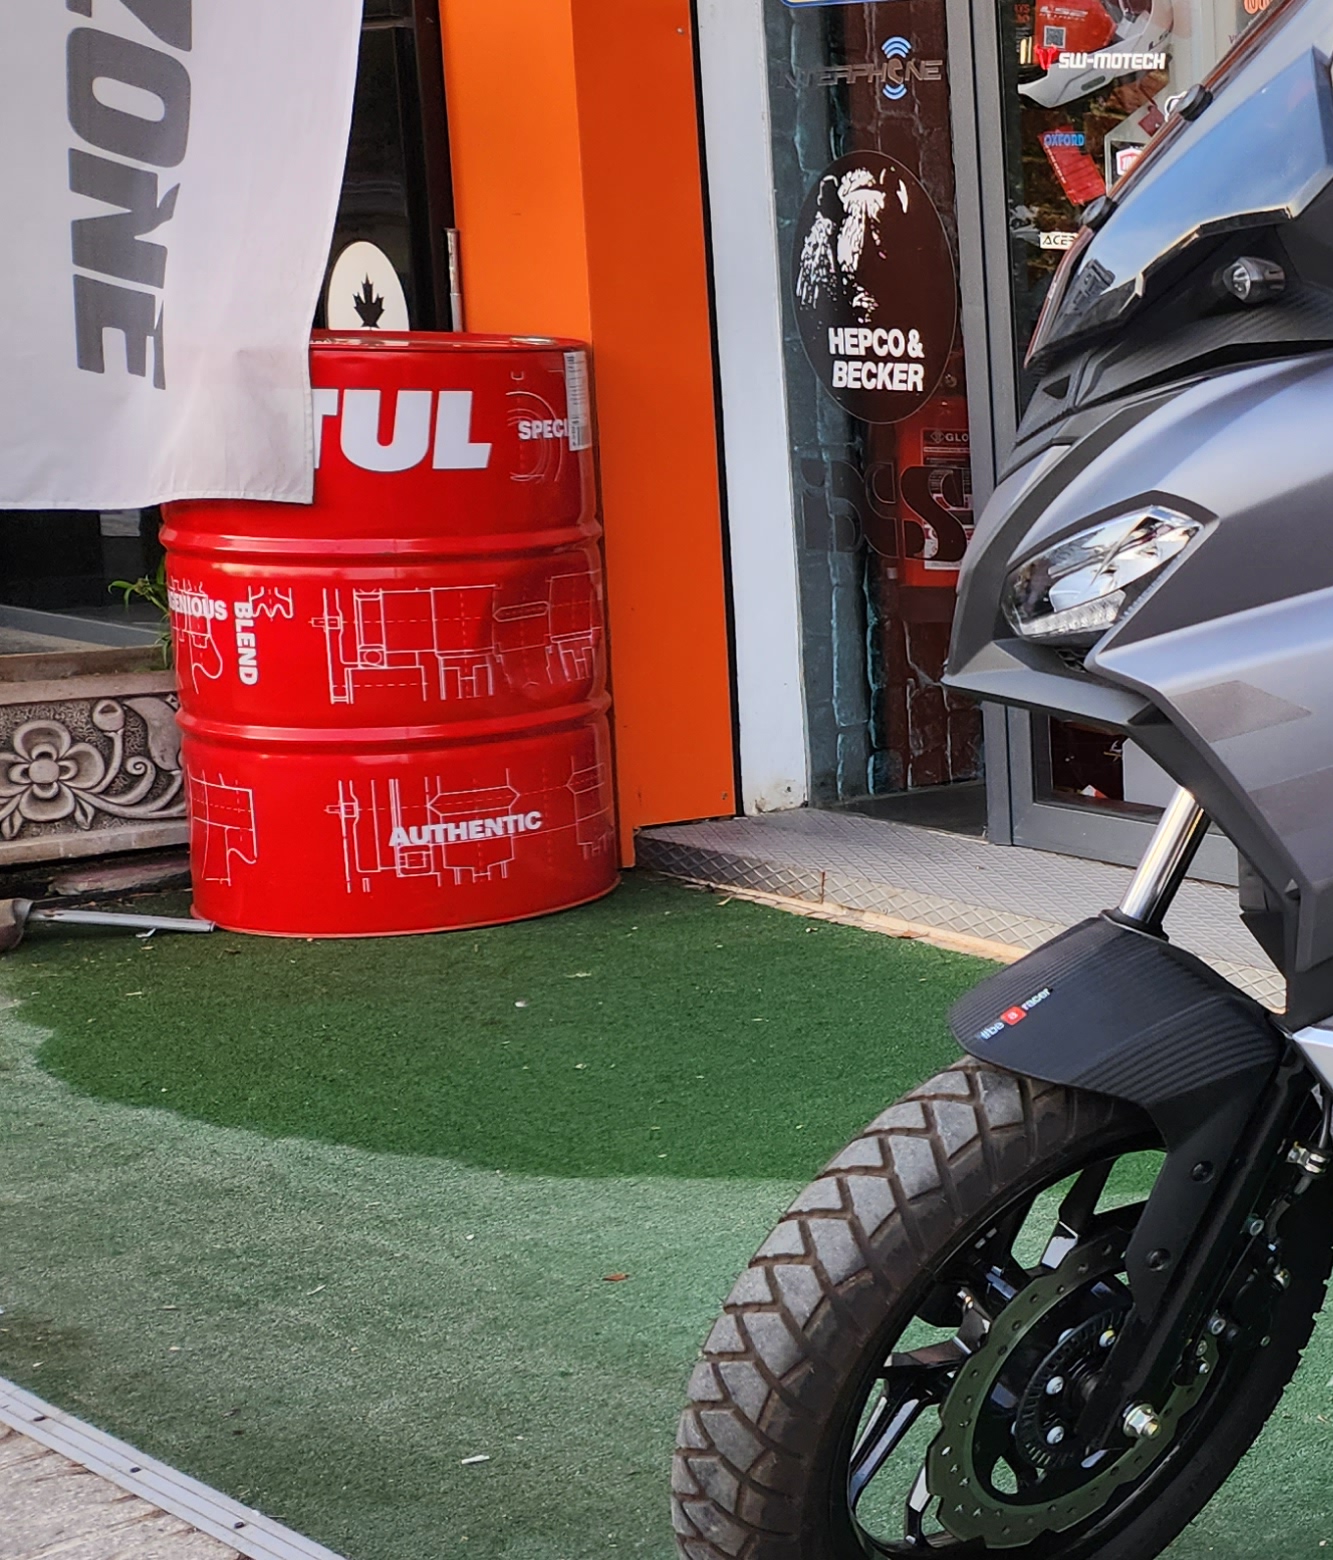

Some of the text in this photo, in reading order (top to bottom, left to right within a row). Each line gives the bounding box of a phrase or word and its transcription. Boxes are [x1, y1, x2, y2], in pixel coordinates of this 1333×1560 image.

[1059, 52, 1166, 69] SW-MOTECH
[1043, 133, 1086, 146] OXFORD
[828, 328, 925, 358] HEPCO &
[832, 360, 925, 391] BECKER
[234, 602, 258, 685] BLEND
[389, 811, 542, 847] AUTHENTIC
